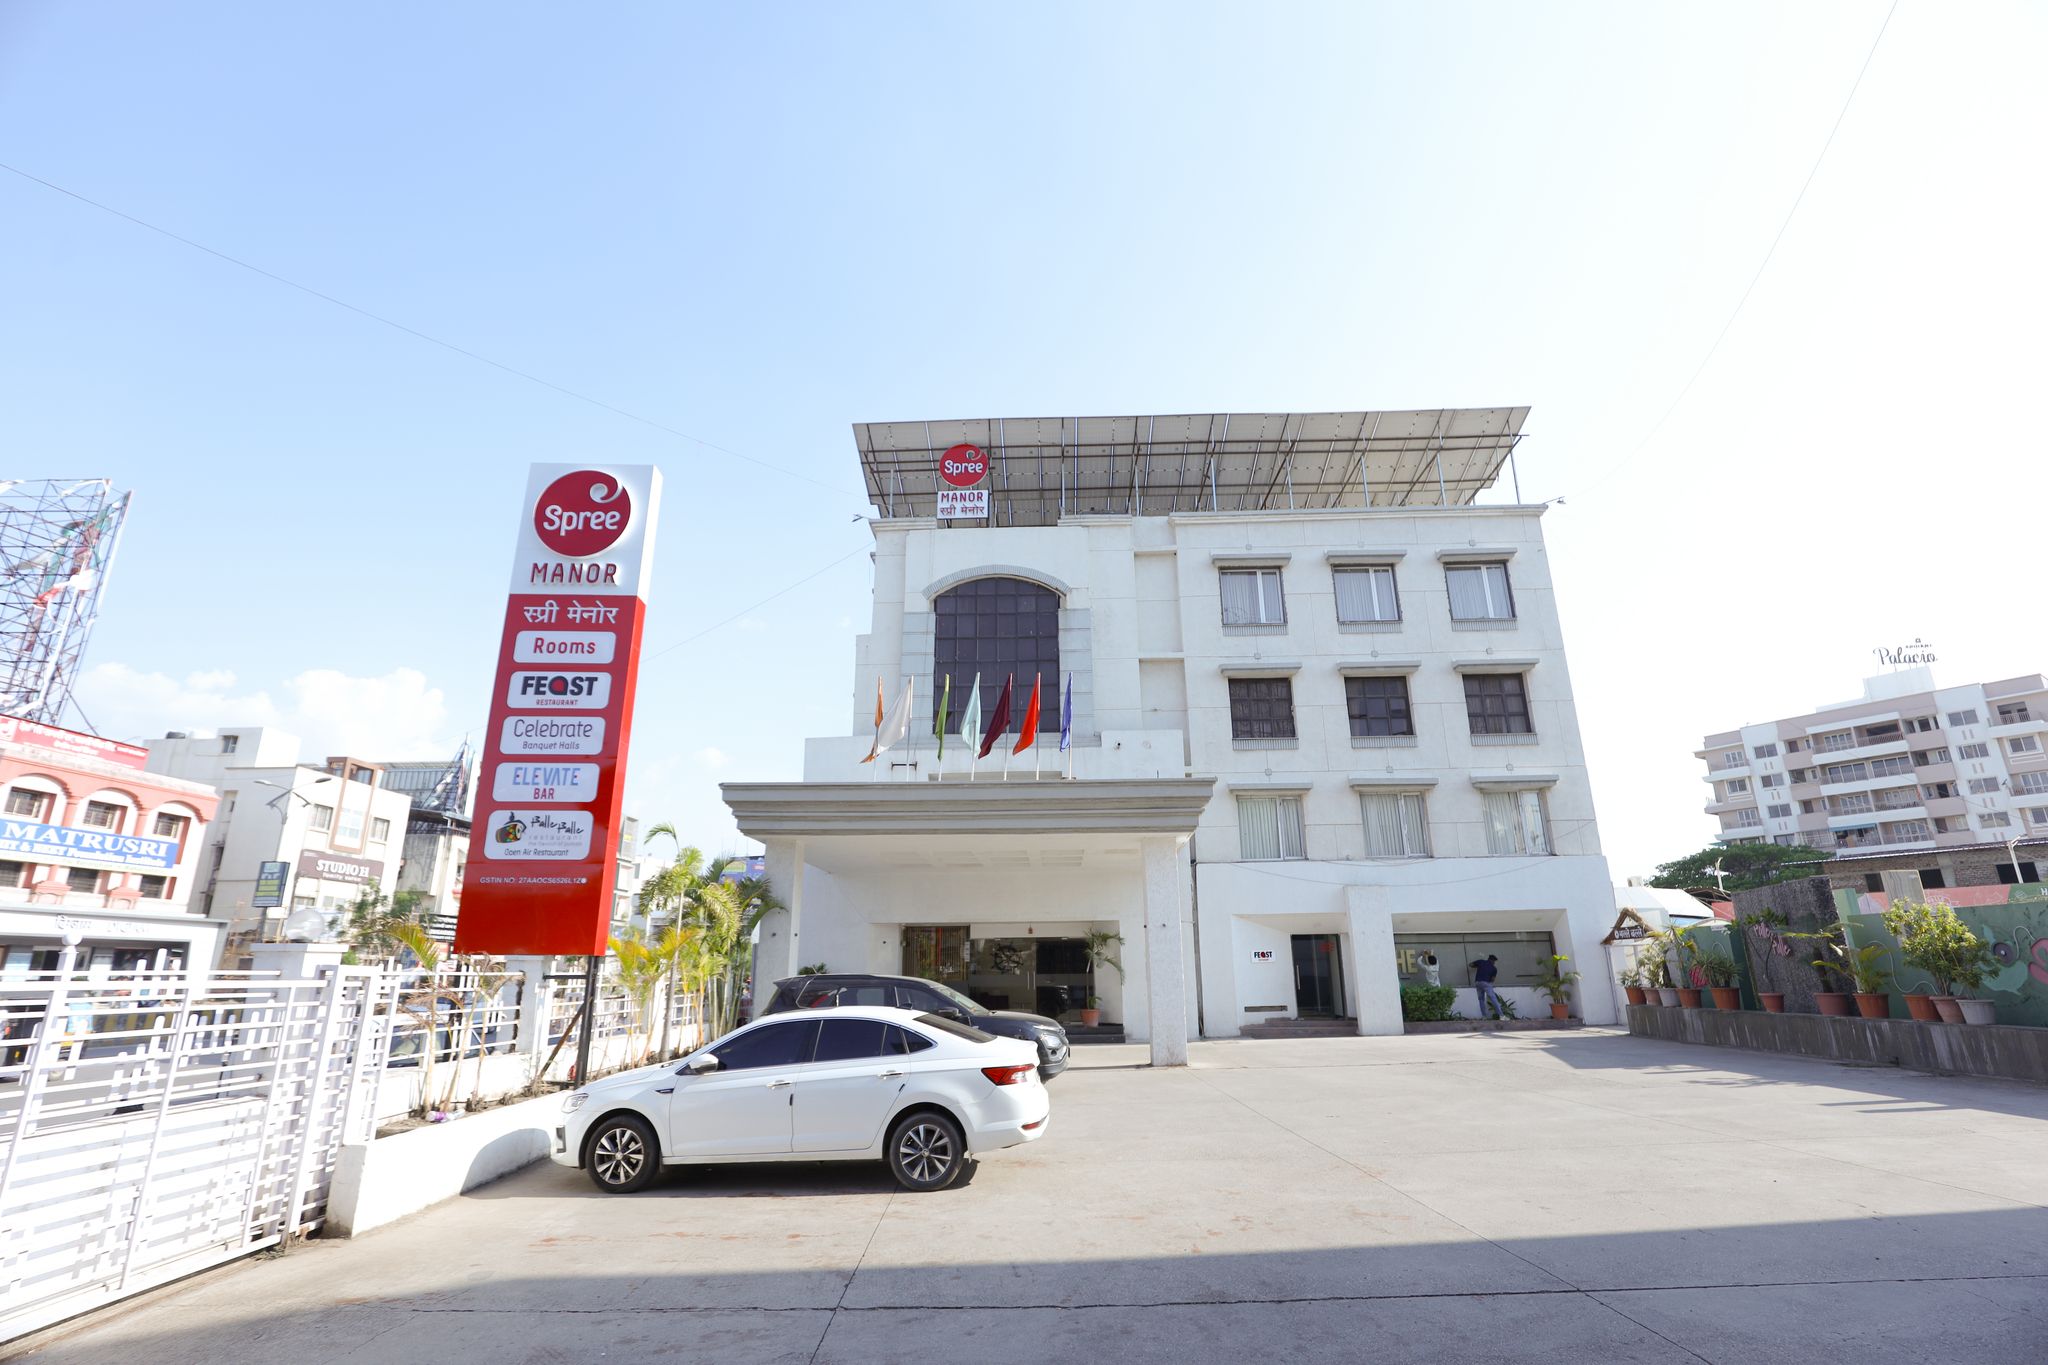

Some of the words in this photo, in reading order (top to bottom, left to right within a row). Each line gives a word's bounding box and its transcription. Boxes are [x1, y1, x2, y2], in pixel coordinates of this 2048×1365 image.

[945, 460, 984, 476] Spree
[941, 491, 984, 502] MANOR
[961, 503, 985, 516] मेनोर
[543, 504, 621, 536] Spree
[530, 562, 618, 585] MANOR
[523, 600, 560, 624] स्प्री
[567, 599, 619, 624] मेनोर
[533, 637, 596, 654] Rooms
[513, 718, 593, 738] Celebrate
[522, 741, 557, 751] Banquet
[559, 741, 580, 750] Halls
[512, 766, 581, 786] ELEVATE
[533, 787, 555, 800] BAR
[2, 821, 169, 858] MATRUSRI
[504, 848, 521, 857] Open
[522, 848, 531, 856] Air
[533, 848, 569, 857] Restaurant
[316, 859, 360, 876] STUDIO
[479, 876, 502, 884] GSTIN
